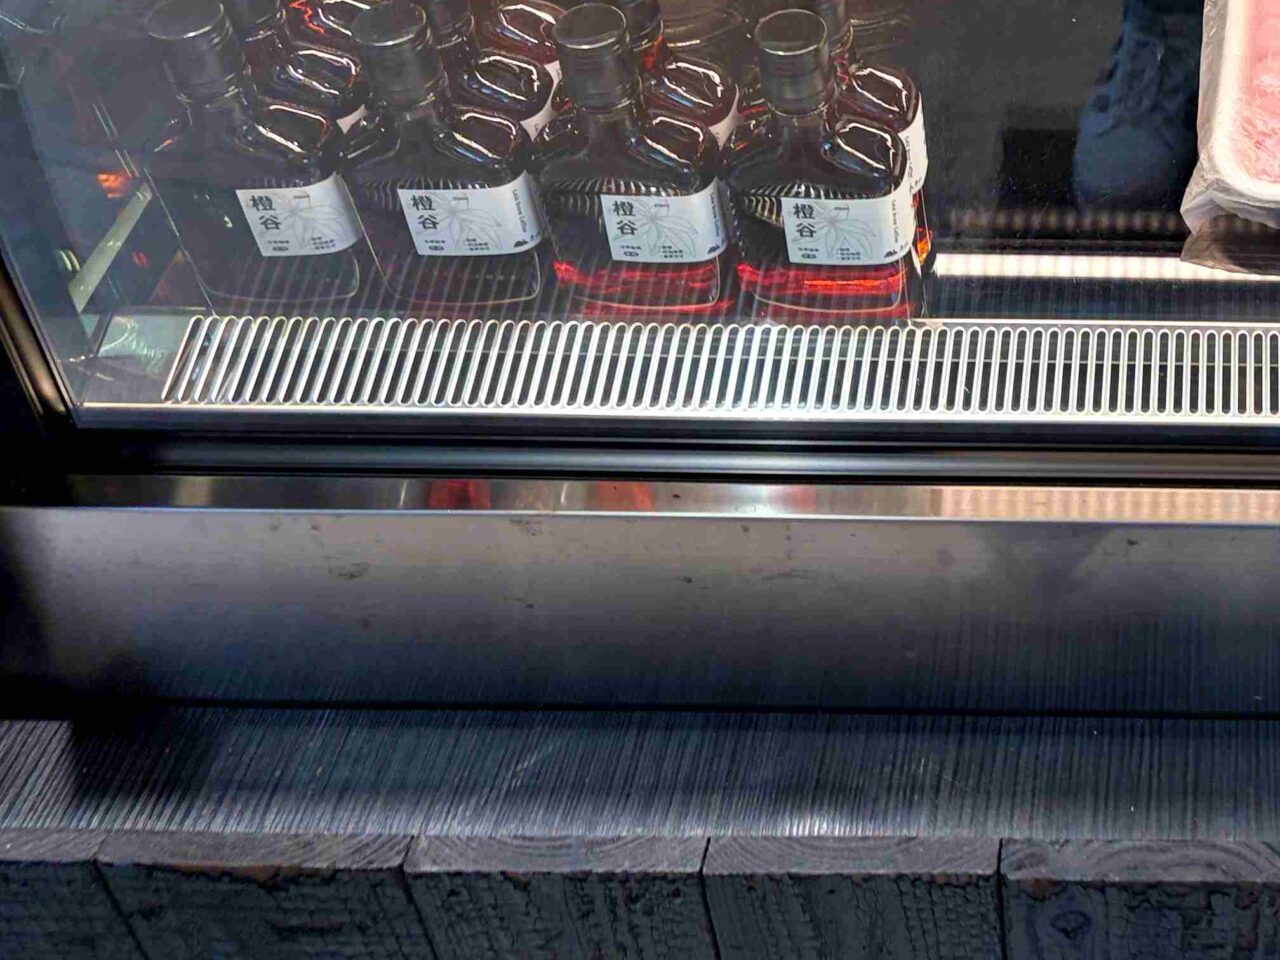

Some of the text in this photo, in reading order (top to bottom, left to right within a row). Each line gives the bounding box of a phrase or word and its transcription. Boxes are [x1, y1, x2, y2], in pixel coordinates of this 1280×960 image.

[411, 194, 439, 230] 橙谷
[612, 201, 638, 236] 橙谷
[793, 203, 817, 238] 橙谷
